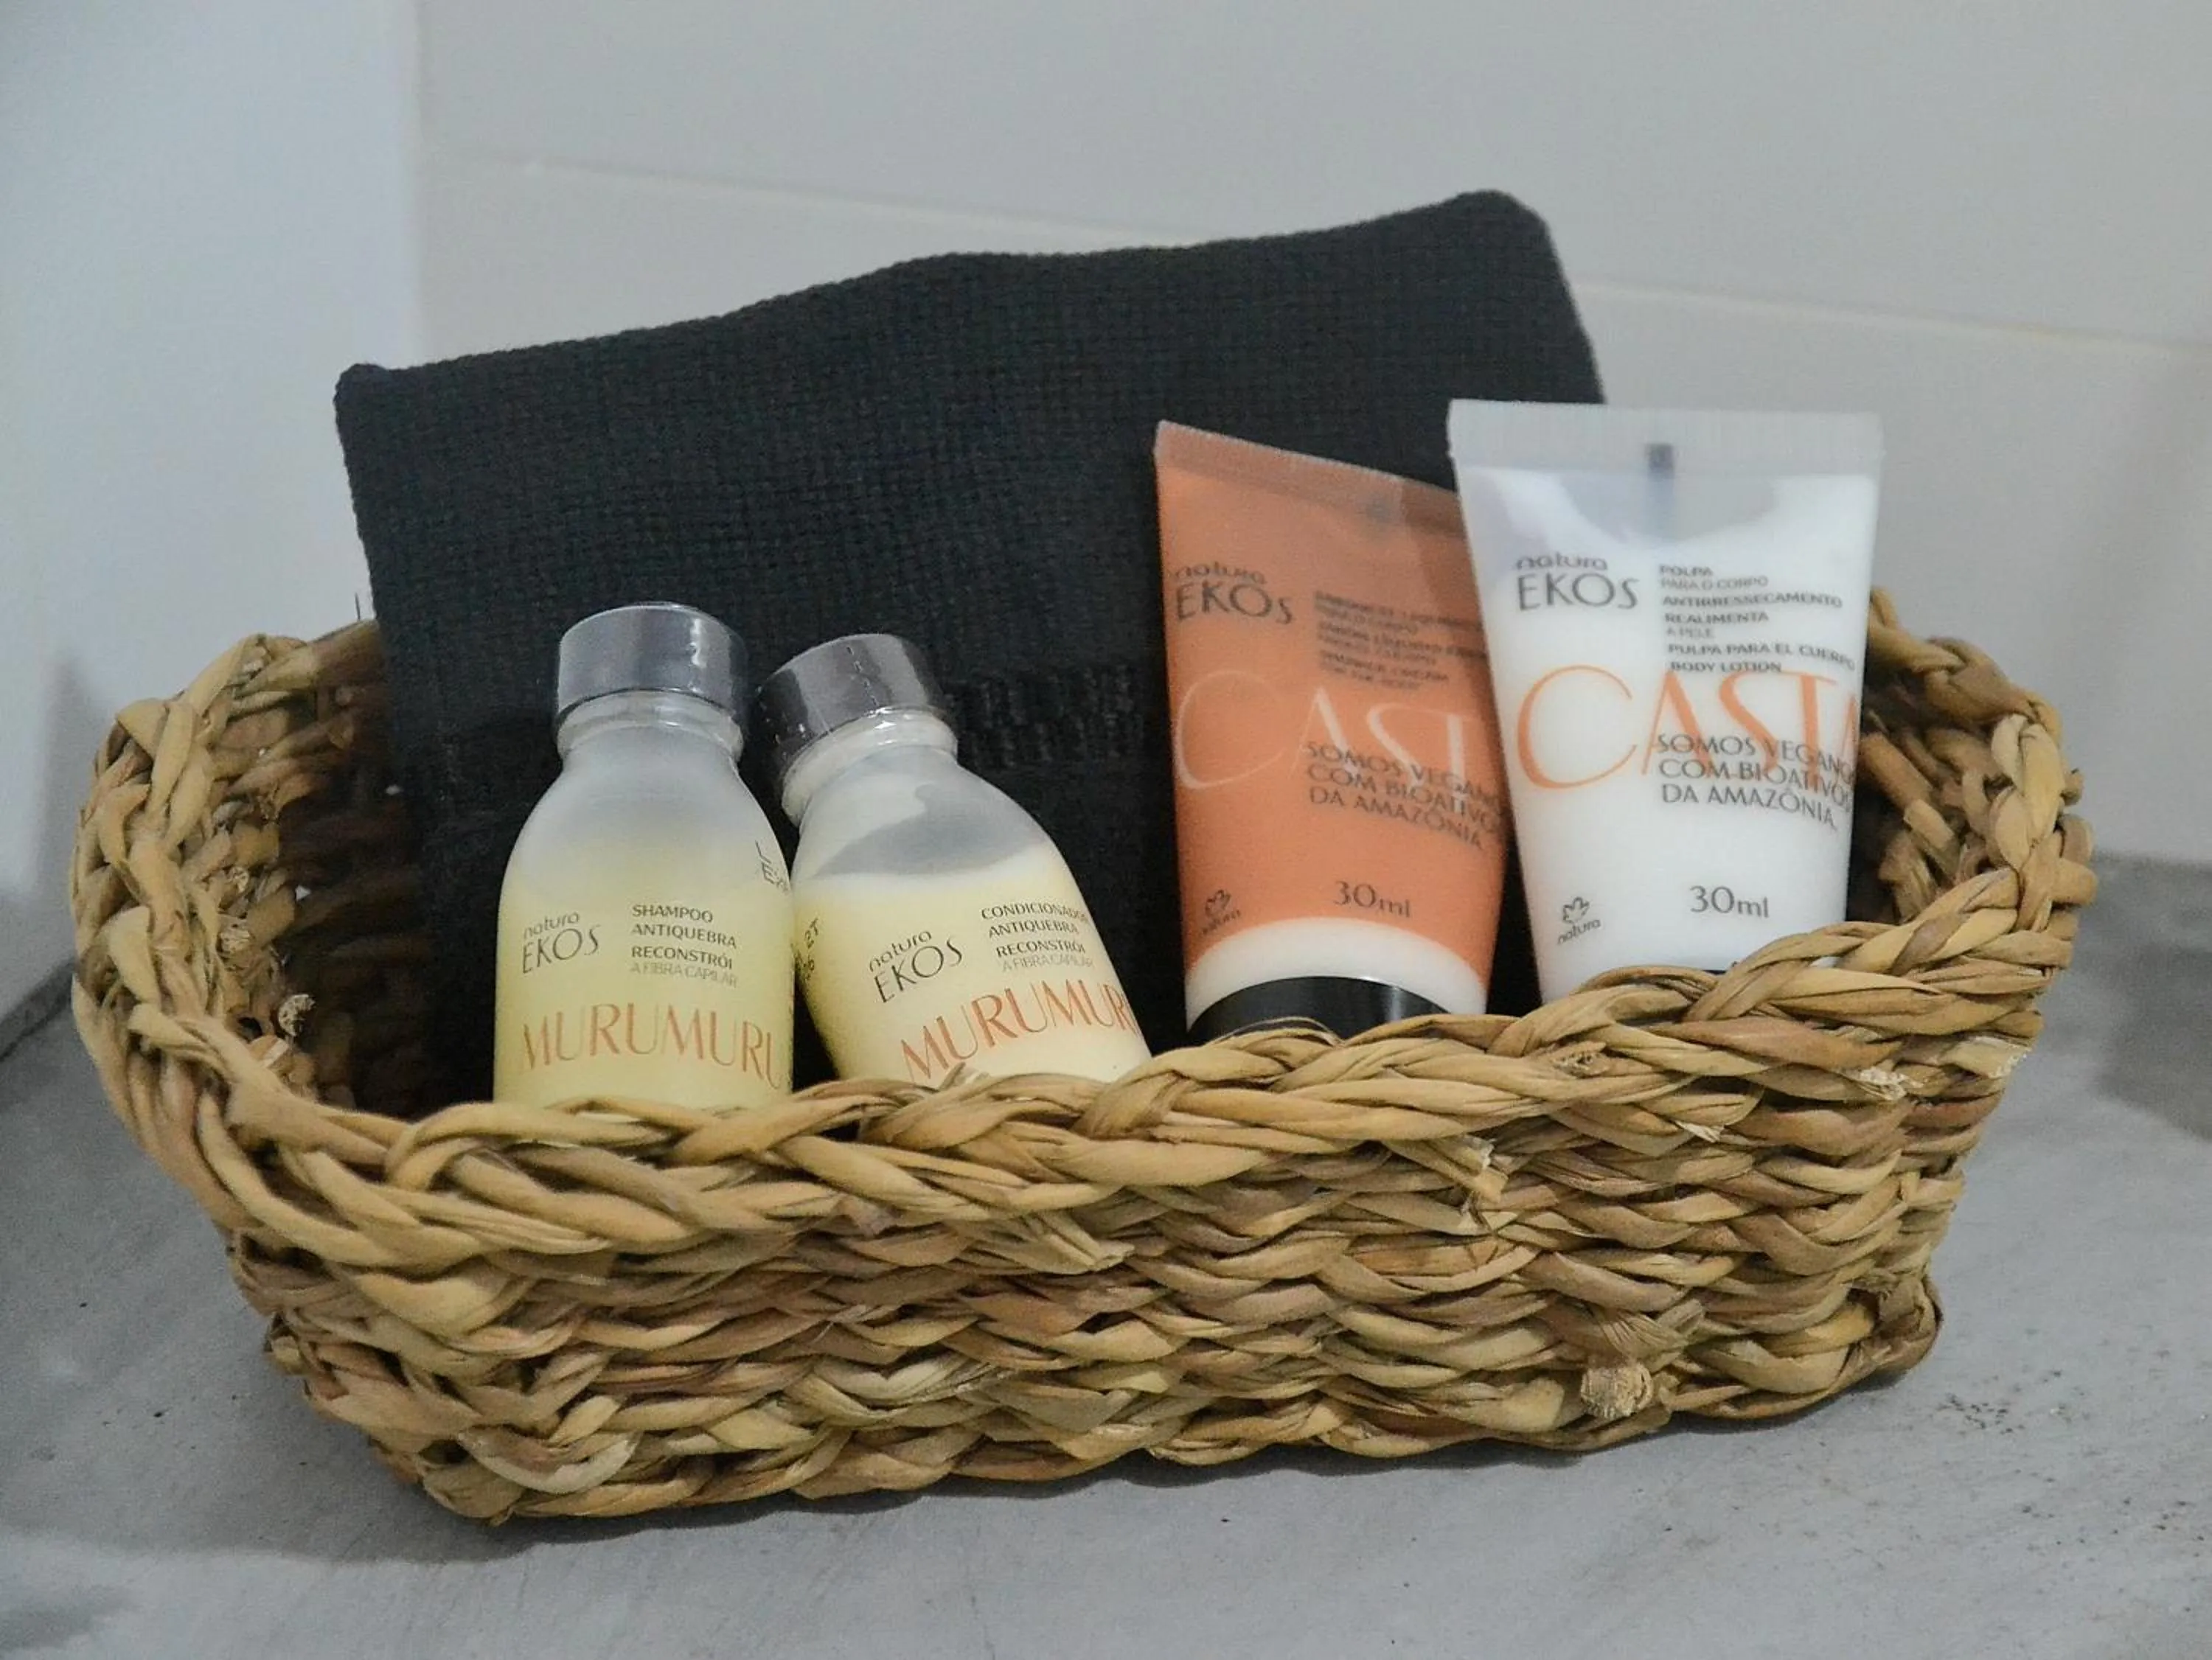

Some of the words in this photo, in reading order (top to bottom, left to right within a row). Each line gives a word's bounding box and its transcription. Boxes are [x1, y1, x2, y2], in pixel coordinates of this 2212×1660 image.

[1516, 551, 1608, 571] natura
[1176, 580, 1295, 624] EKOS
[1517, 573, 1639, 611] EKOS
[1726, 643, 1770, 655] PARA
[1775, 643, 1793, 655] EL
[1670, 661, 1716, 673] BODY
[1721, 662, 1782, 673] LOTION
[1659, 733, 1756, 756] SOMOS
[1307, 741, 1404, 777] SOMOS
[1659, 758, 1731, 780] COM
[1308, 762, 1377, 793] COM
[1310, 785, 1345, 807] DA
[1663, 784, 1699, 803] DA
[1708, 784, 1837, 831] AMAZÔNIA
[1333, 880, 1411, 918] 30ml
[1690, 885, 1770, 918] 30ml
[523, 911, 580, 940] natura
[632, 904, 714, 924] SHAMPOO
[630, 923, 737, 949] ANTIQUEBRA
[988, 919, 1079, 938] ANTIQUEBRA
[1557, 918, 1601, 945] natura
[522, 923, 602, 974] EKOS
[631, 945, 733, 971] RECONSTRÓI
[869, 930, 932, 973] natura
[874, 935, 962, 1003] EKOS
